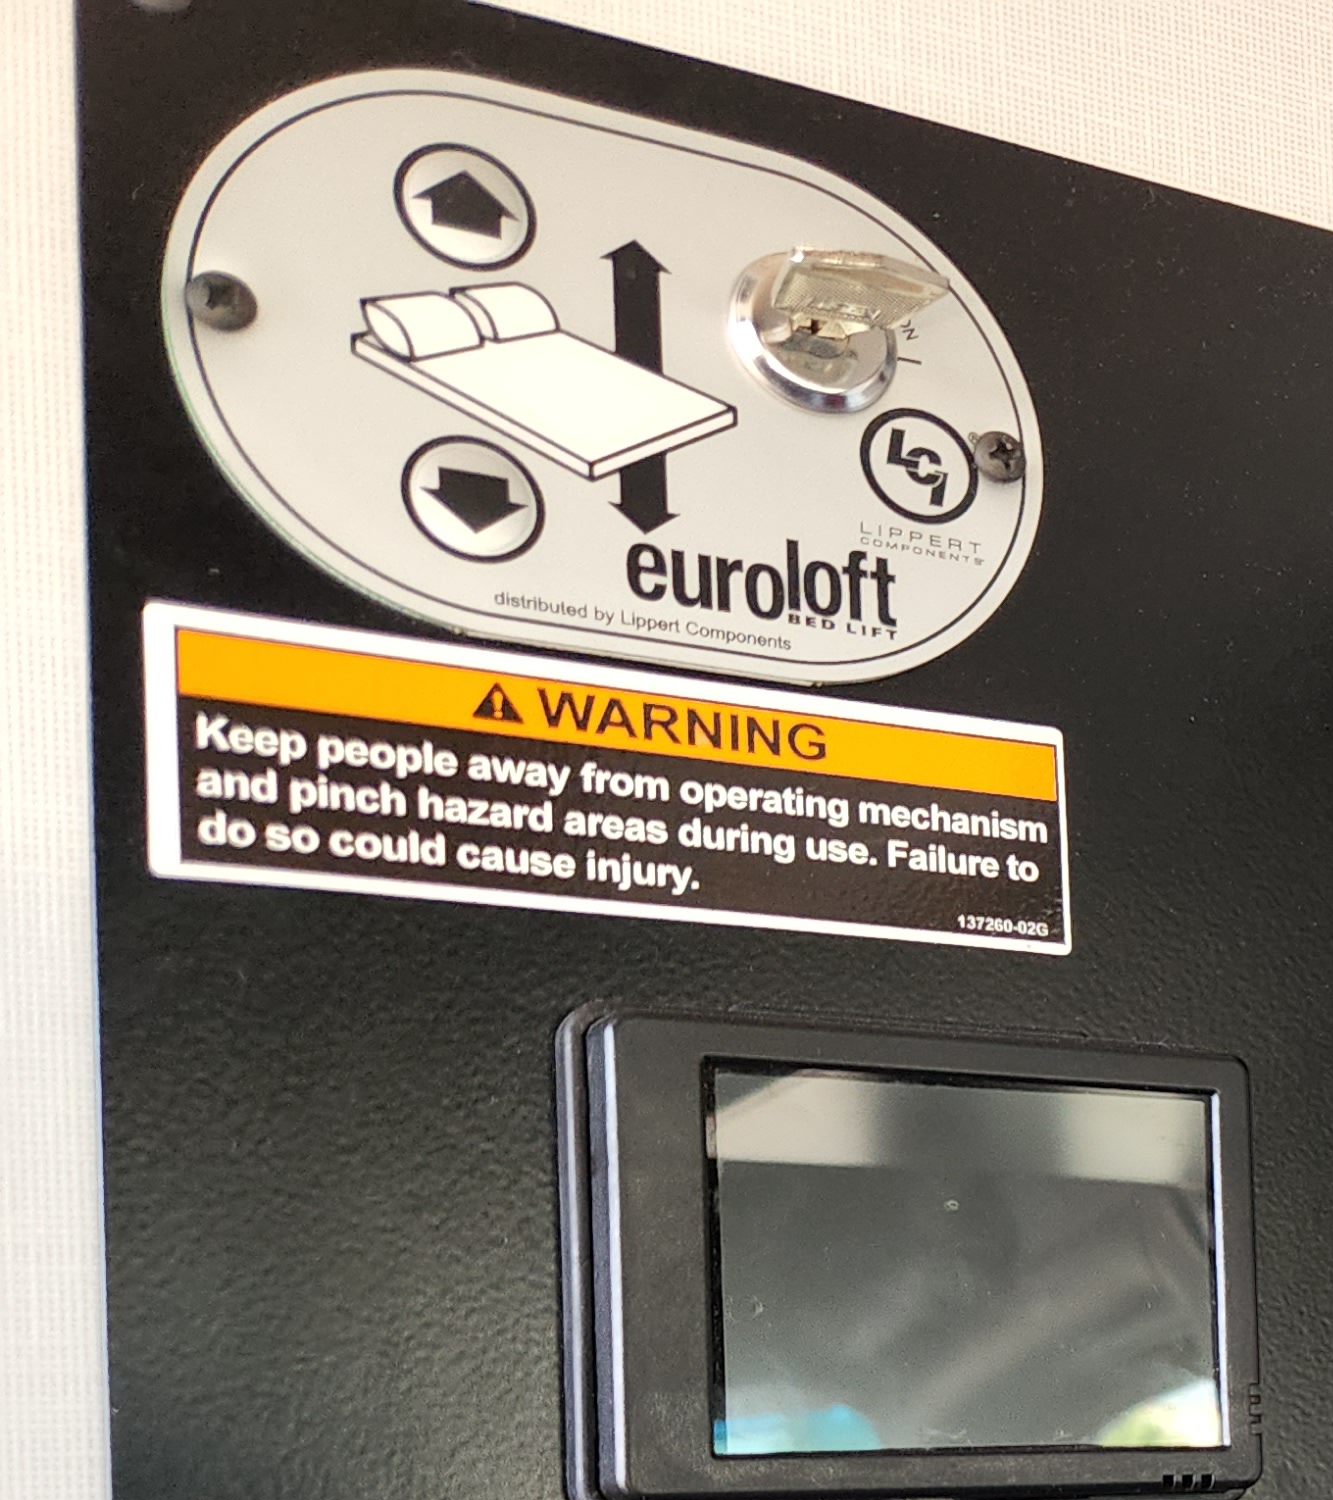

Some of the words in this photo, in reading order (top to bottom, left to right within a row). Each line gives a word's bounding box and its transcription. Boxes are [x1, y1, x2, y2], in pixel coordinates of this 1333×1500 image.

[860, 521, 982, 554] LIPPERT
[860, 537, 986, 566] COMPONENTS
[626, 539, 897, 627] euroloft
[494, 592, 588, 619] distributed
[594, 606, 614, 625] by
[621, 612, 680, 634] Lippert
[686, 622, 792, 650] Components
[788, 613, 835, 630] BED
[846, 623, 897, 641] LIFT
[538, 687, 827, 761] WARNING
[196, 711, 307, 764] Keep
[317, 735, 458, 779] people
[467, 760, 570, 797] away
[579, 761, 669, 801] from
[679, 778, 849, 827] operating
[859, 802, 1048, 844] mechanism
[196, 767, 278, 804] and
[289, 776, 407, 818] pinch
[418, 788, 553, 832] hazard
[564, 807, 668, 845] areas
[678, 818, 795, 864] during
[806, 837, 877, 867] use.
[888, 840, 1000, 878] Failure
[1006, 854, 1039, 883] to
[198, 809, 256, 849] do
[265, 825, 320, 854] so
[328, 830, 446, 866] could
[456, 842, 576, 879] cause
[586, 849, 700, 895] injury.
[957, 914, 1049, 937] 137260-02G
